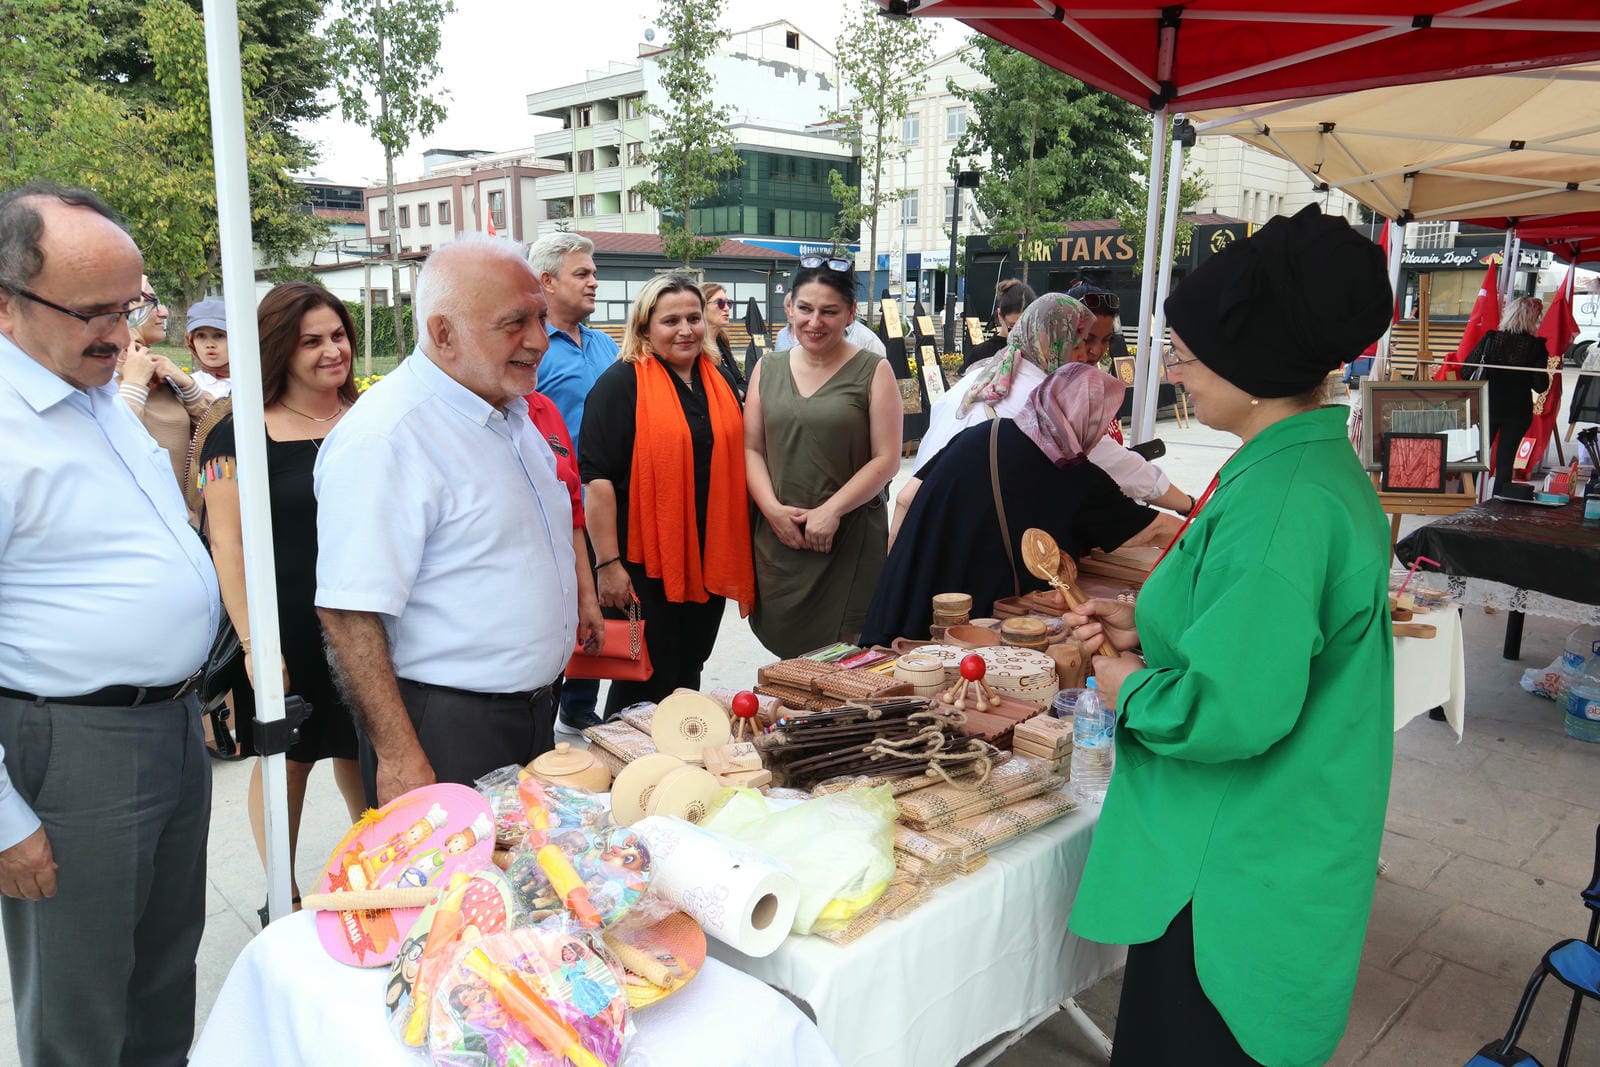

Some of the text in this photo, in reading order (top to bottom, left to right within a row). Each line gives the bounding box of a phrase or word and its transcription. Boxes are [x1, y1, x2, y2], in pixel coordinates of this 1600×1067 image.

[807, 246, 836, 256] HALKB
[1057, 236, 1138, 262] TAKS
[1401, 250, 1473, 267] Vitamin Depo
